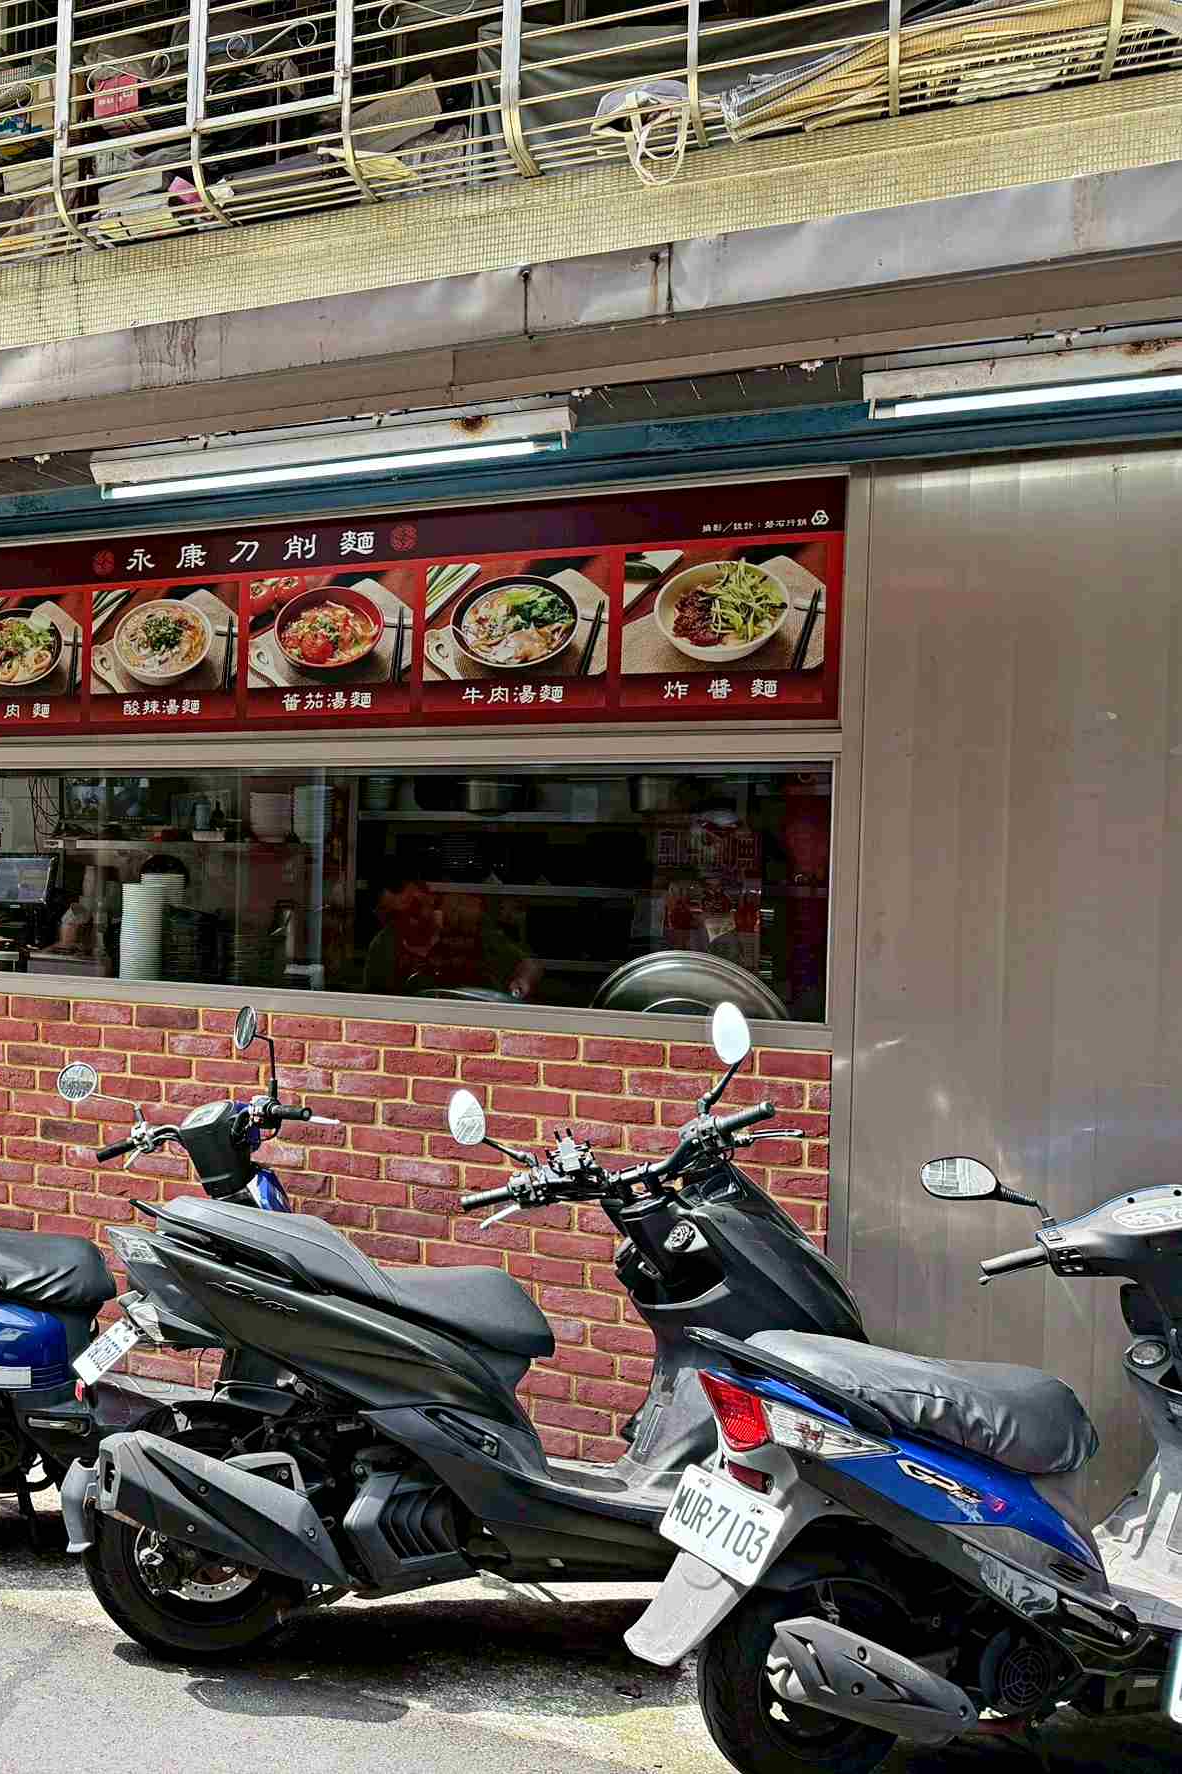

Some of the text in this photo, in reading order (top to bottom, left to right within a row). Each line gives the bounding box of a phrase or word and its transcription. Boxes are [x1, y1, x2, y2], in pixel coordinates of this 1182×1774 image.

[126, 529, 376, 573] 永康刀削麵
[461, 683, 565, 706] 牛肉湯麵
[663, 678, 779, 701] 炸醬麵
[122, 698, 201, 717] 酸辣湯麵
